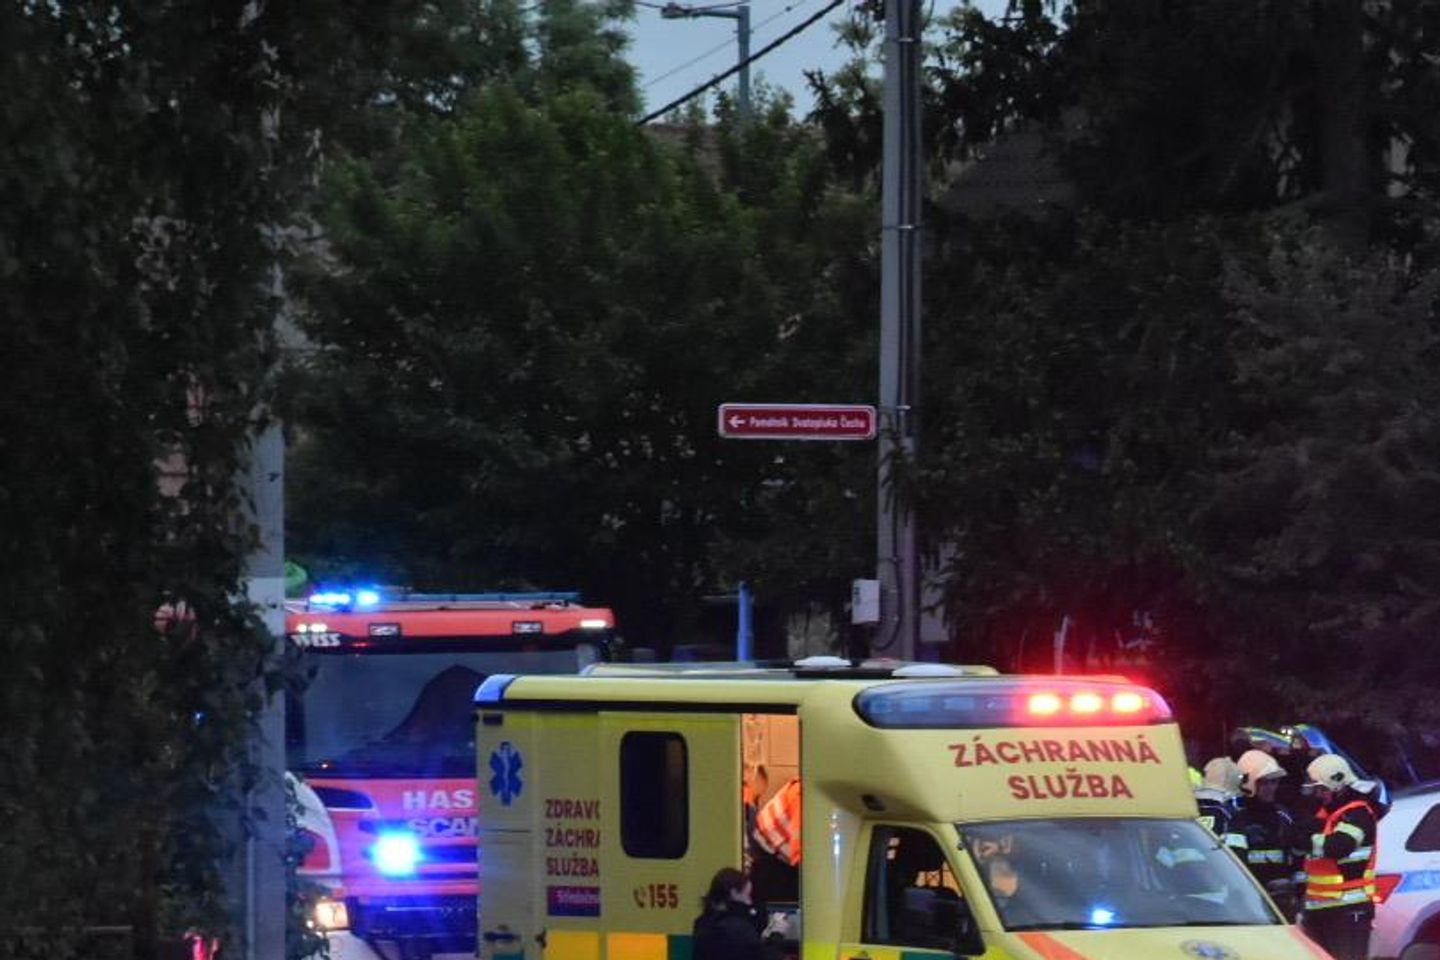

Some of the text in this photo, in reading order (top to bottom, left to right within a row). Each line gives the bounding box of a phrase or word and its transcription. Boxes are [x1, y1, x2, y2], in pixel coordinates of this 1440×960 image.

[948, 734, 1161, 767] ZÁCHRANNÁ
[1008, 768, 1134, 800] SLUŽBA
[648, 883, 679, 909] 155
